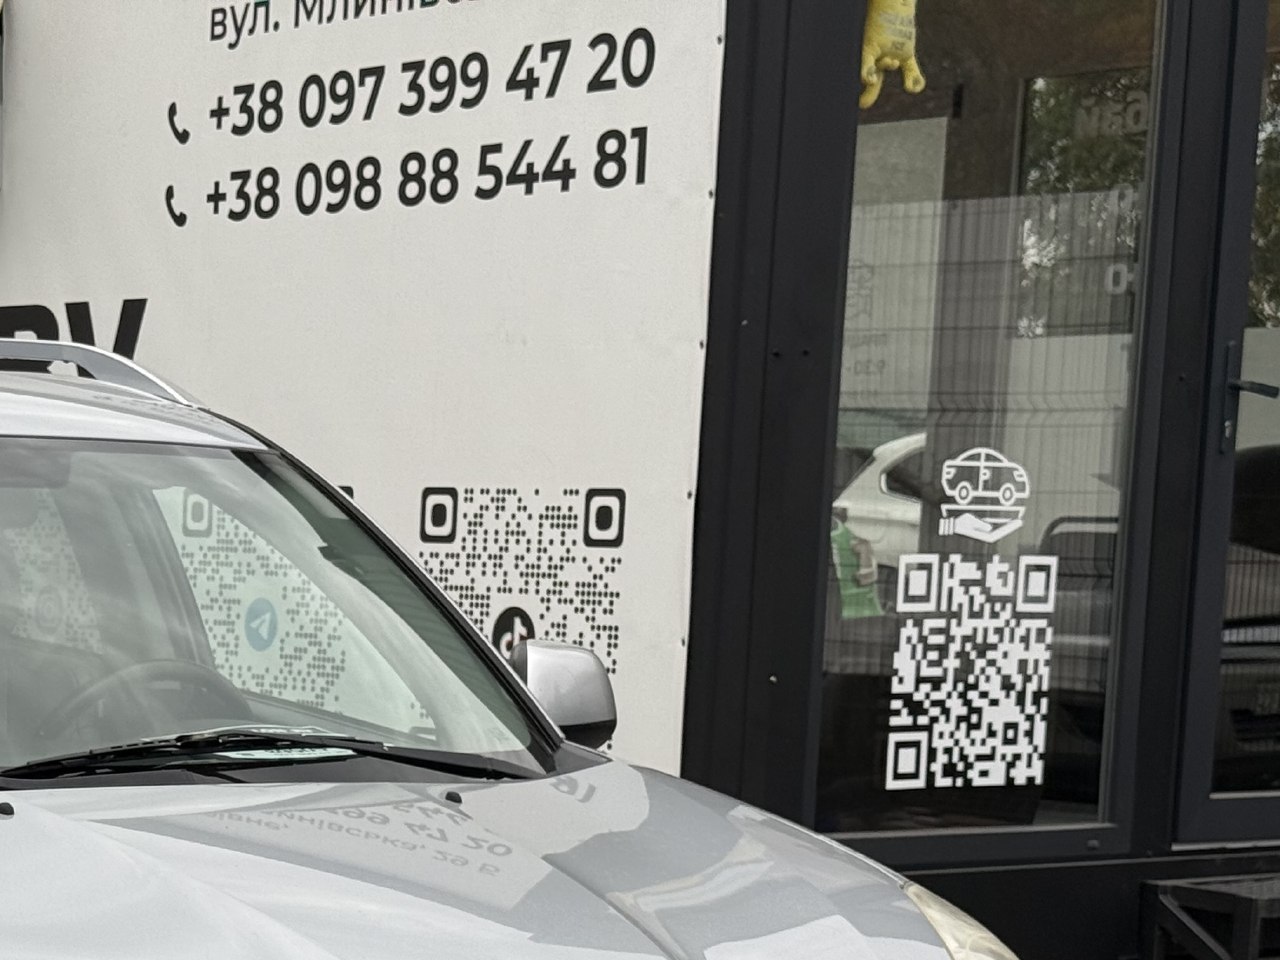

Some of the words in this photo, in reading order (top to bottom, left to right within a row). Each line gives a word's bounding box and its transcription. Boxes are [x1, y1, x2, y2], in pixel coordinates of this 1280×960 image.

[210, 0, 280, 50] вул.
[209, 79, 284, 137] +38
[298, 65, 386, 128] 097
[398, 51, 489, 117] 399
[505, 38, 572, 101] 47
[586, 27, 656, 94] 20
[206, 166, 280, 222] +38
[295, 156, 382, 216] 098
[398, 147, 459, 207] 88
[474, 134, 577, 201] 544
[593, 126, 648, 189] 81
